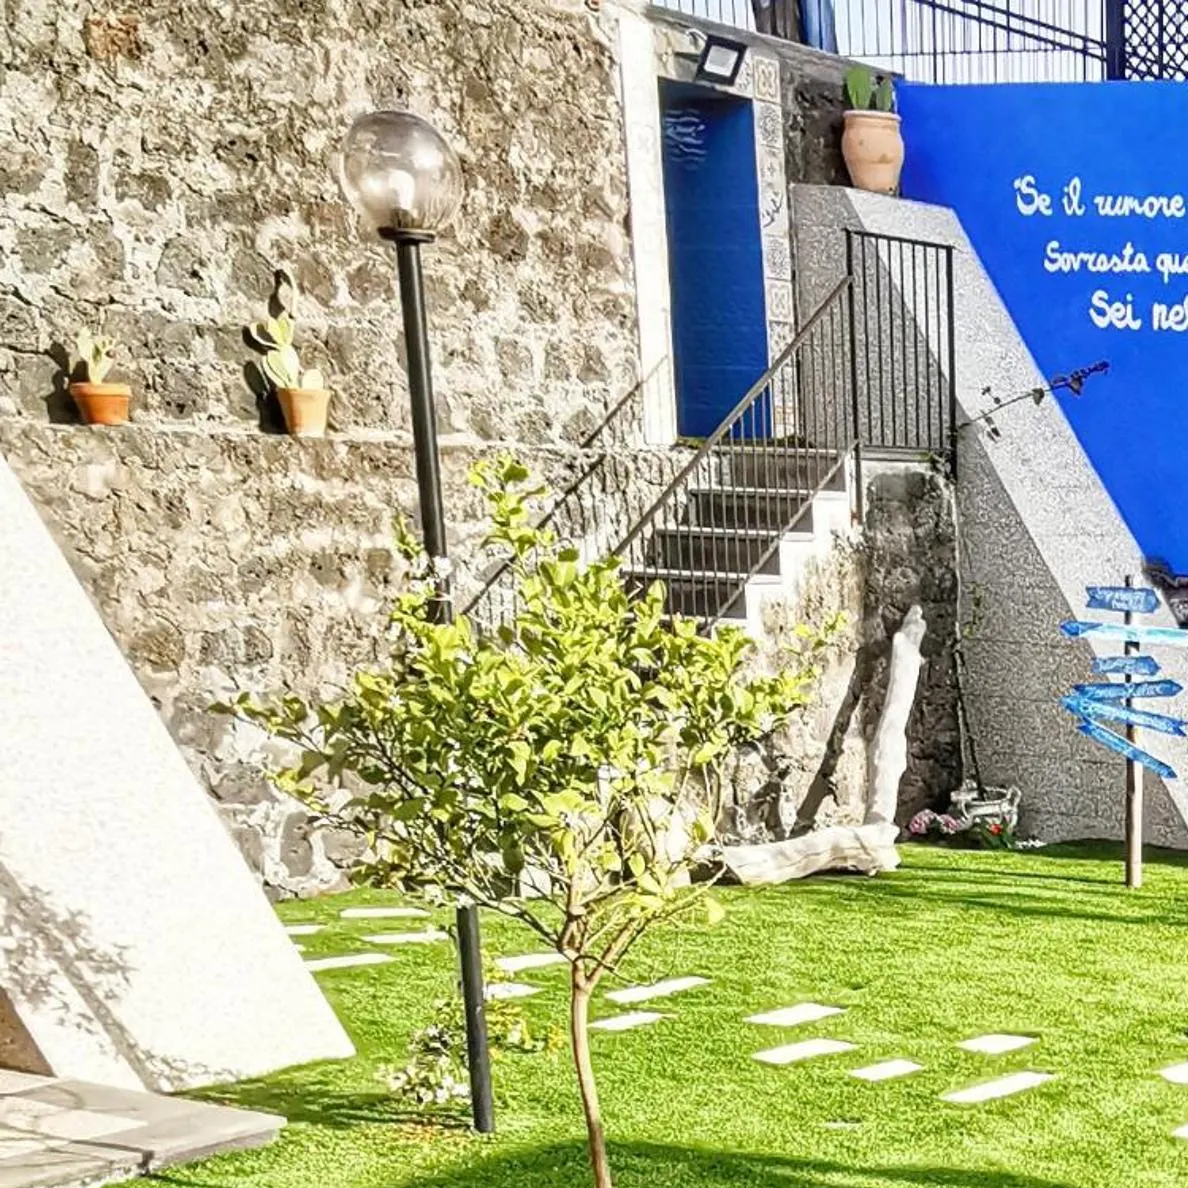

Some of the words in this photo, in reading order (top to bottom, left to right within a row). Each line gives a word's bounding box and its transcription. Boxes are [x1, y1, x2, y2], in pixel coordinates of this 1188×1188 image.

[1062, 177, 1085, 216] il
[1094, 195, 1186, 218] rumore
[1043, 240, 1151, 273] Sovrasta
[1089, 290, 1142, 330] Sei
